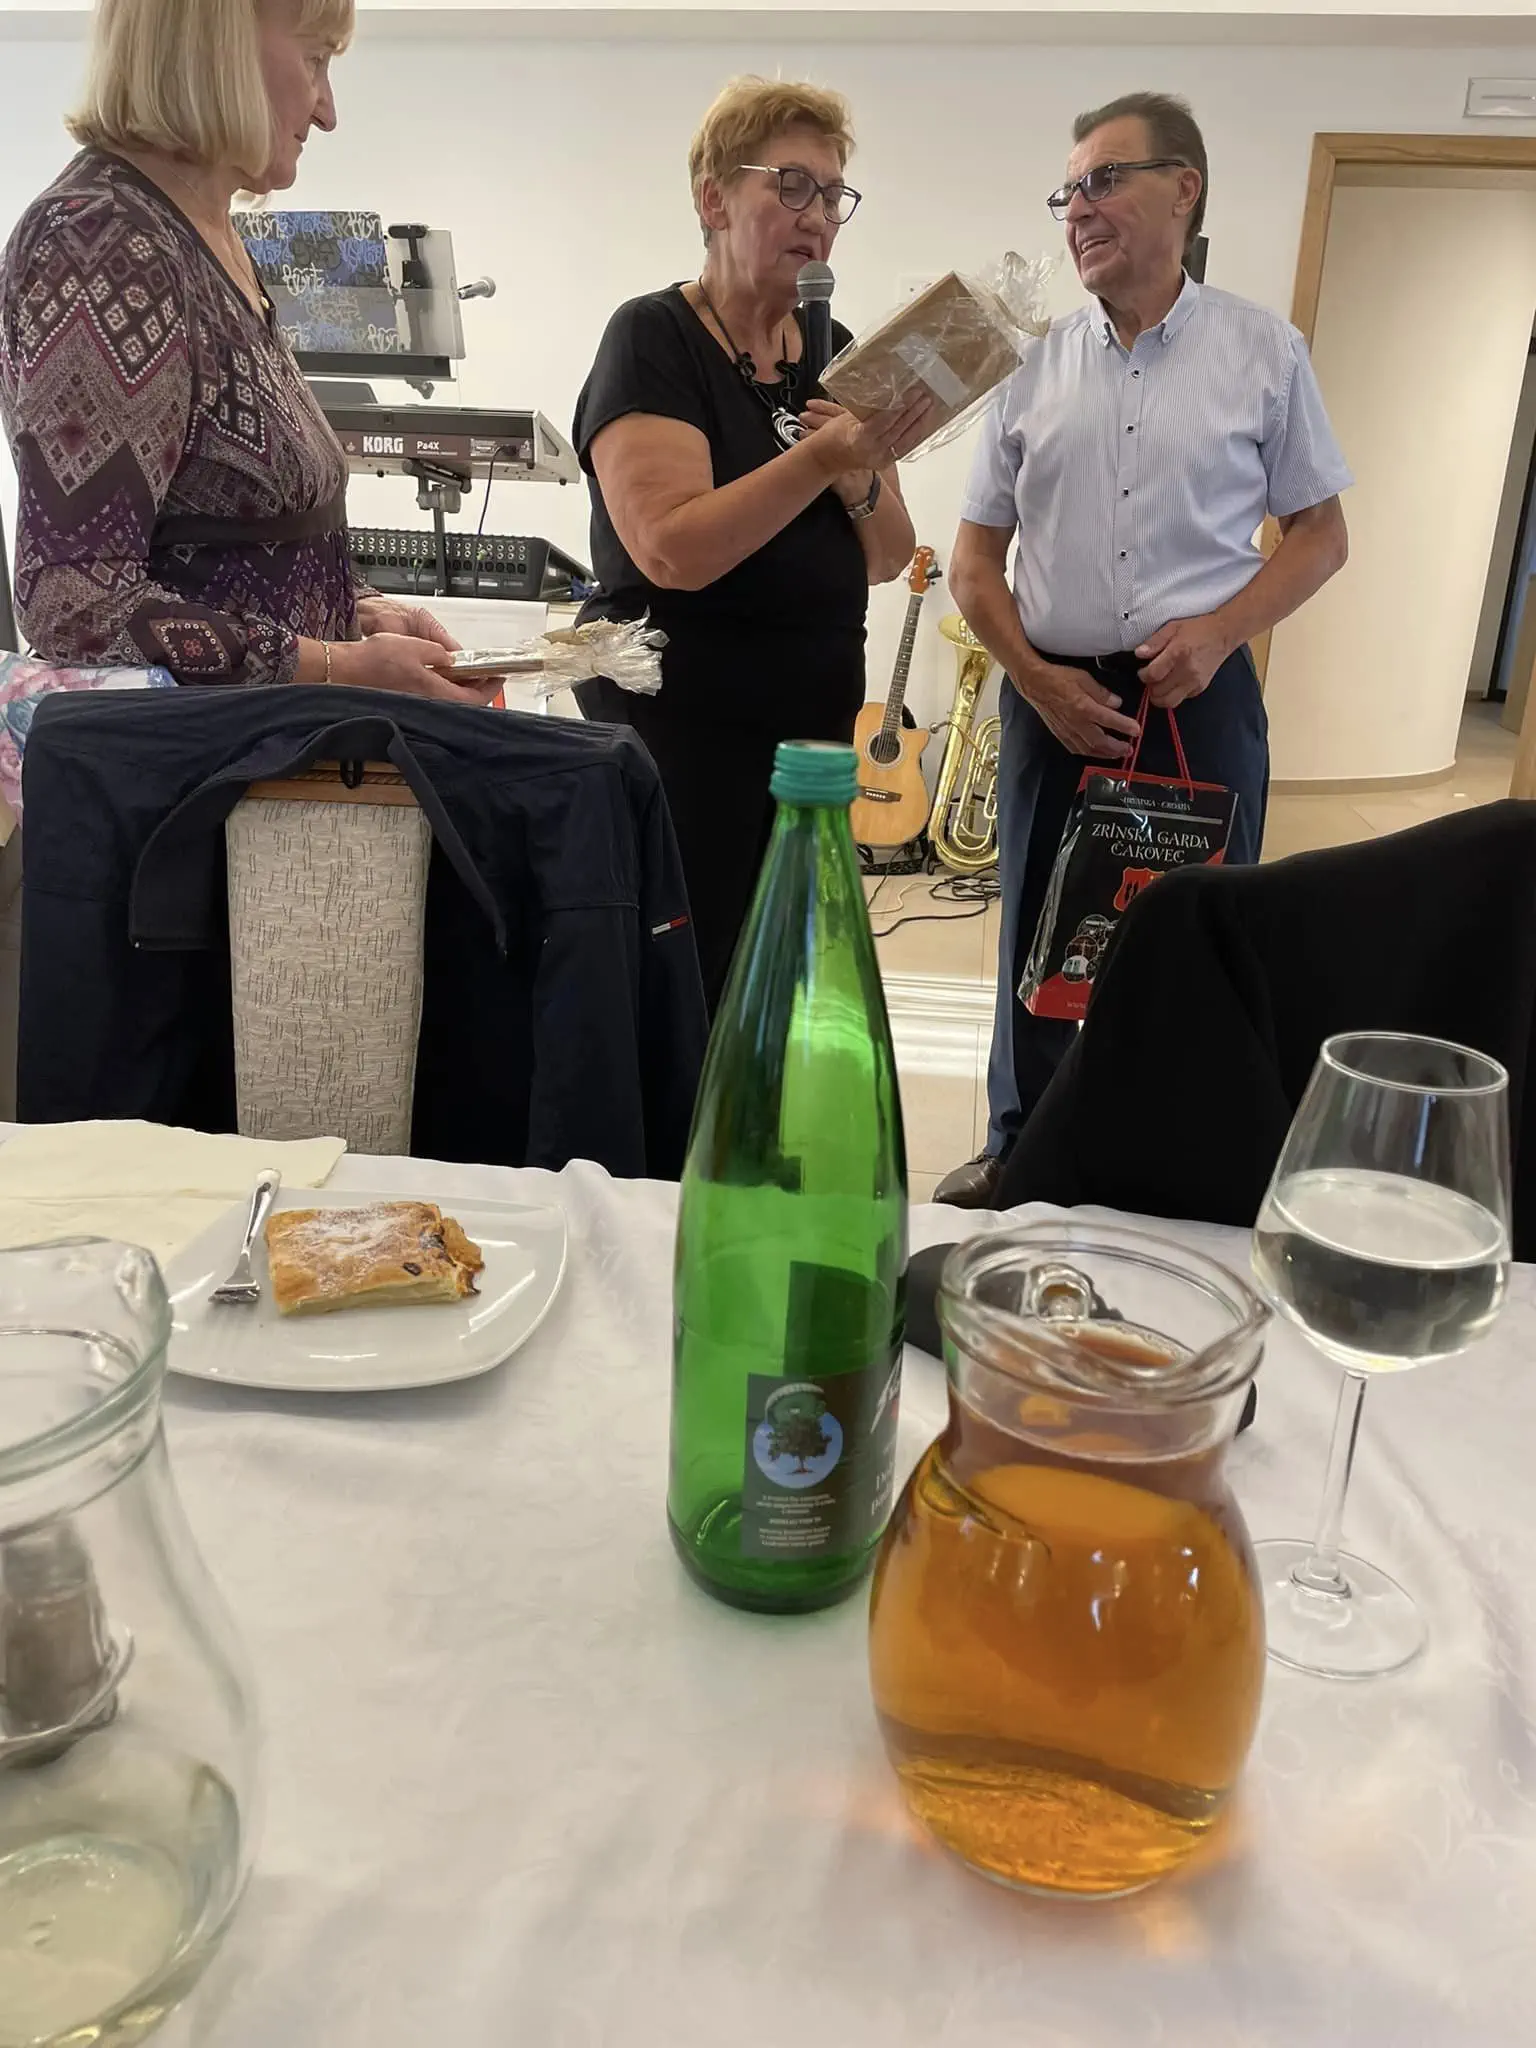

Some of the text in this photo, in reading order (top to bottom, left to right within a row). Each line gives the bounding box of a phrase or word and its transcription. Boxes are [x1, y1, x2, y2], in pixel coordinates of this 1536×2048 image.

[362, 436, 404, 454] KORG
[416, 441, 440, 450] Pa4X
[1091, 822, 1210, 849] ZRINSKA GARDA
[1110, 840, 1185, 864] ČAKOVEC
